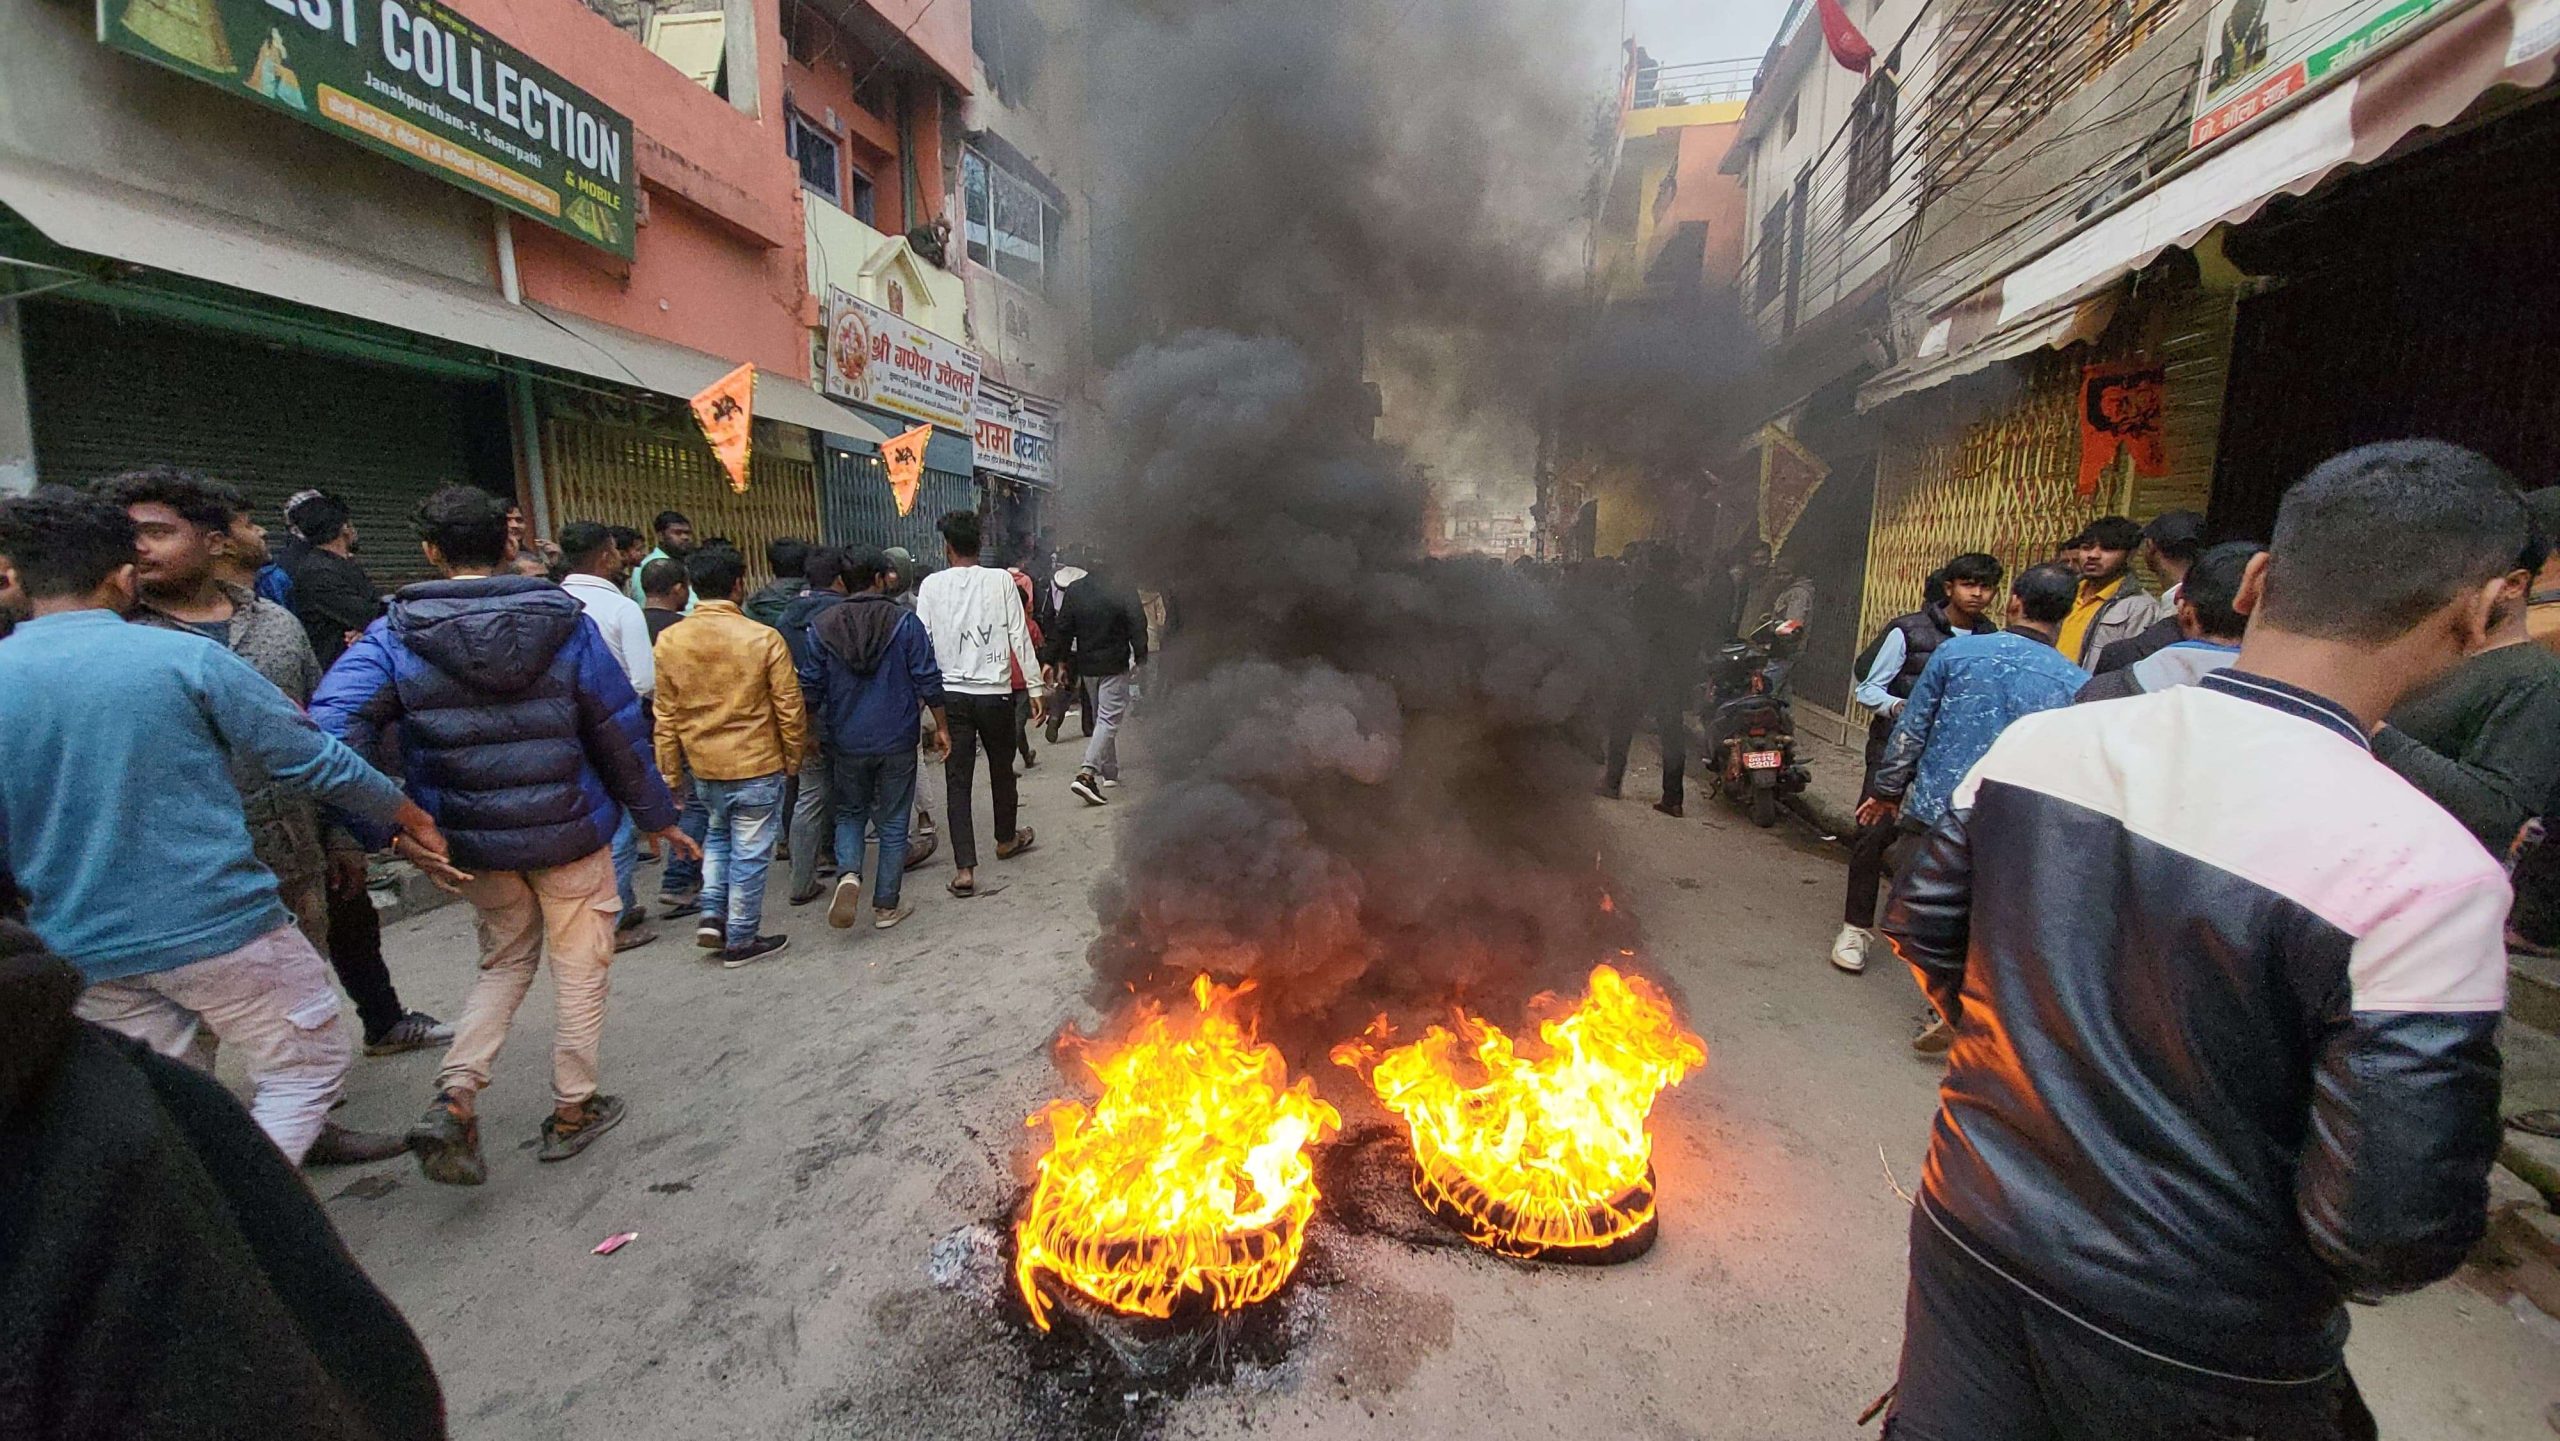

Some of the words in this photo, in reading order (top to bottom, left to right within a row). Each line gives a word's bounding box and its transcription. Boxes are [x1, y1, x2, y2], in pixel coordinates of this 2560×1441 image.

[381, 0, 620, 184] COLLECTION
[484, 128, 542, 168] Sonarpatti
[565, 169, 576, 188] &
[578, 175, 621, 211] MOBILE
[871, 333, 891, 364] श्री
[895, 346, 932, 381] गणेश
[935, 360, 974, 398] ज्वेलर्स
[975, 418, 1012, 456] रामा
